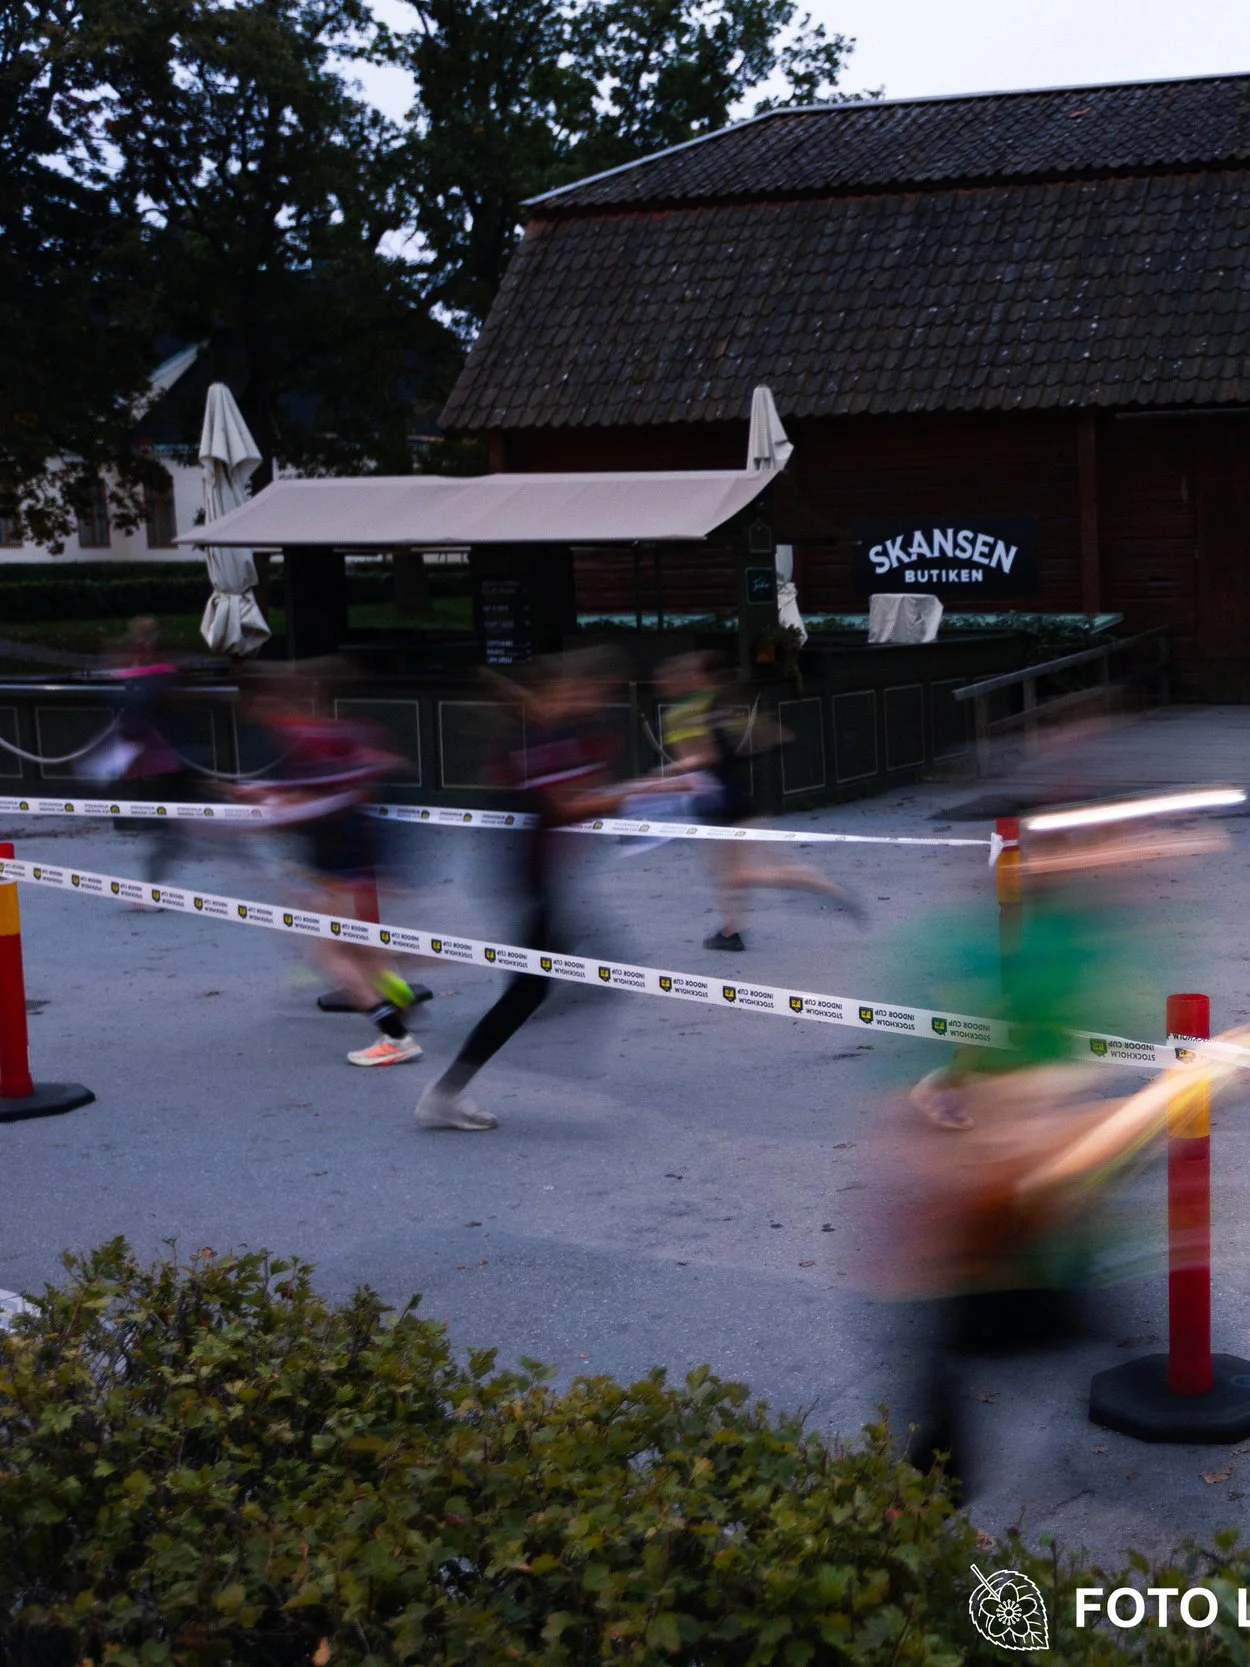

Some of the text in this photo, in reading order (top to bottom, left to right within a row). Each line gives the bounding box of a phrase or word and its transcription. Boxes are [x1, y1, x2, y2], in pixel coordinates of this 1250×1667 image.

[869, 528, 1018, 574] SKANSEN
[904, 569, 984, 583] BUTIKEN
[623, 970, 645, 978] INDOOR
[613, 978, 645, 988] STOCKHOLM
[685, 980, 708, 988] INDOOR
[675, 987, 708, 998] STOCKHOLM
[750, 990, 773, 999] INDOOR
[739, 998, 774, 1008] STOCKHOLM
[818, 1000, 842, 1009] INDOOR
[806, 1008, 843, 1019] STOCKHOLM
[875, 1009, 914, 1020] INDOOR CUP
[876, 1019, 915, 1030] STOCKHOLM
[963, 1021, 990, 1031] INDOOR
[950, 1030, 990, 1042] STOCKHOLM
[1124, 1042, 1154, 1051] INDOOR
[1111, 1050, 1156, 1061] STOCKHOLM
